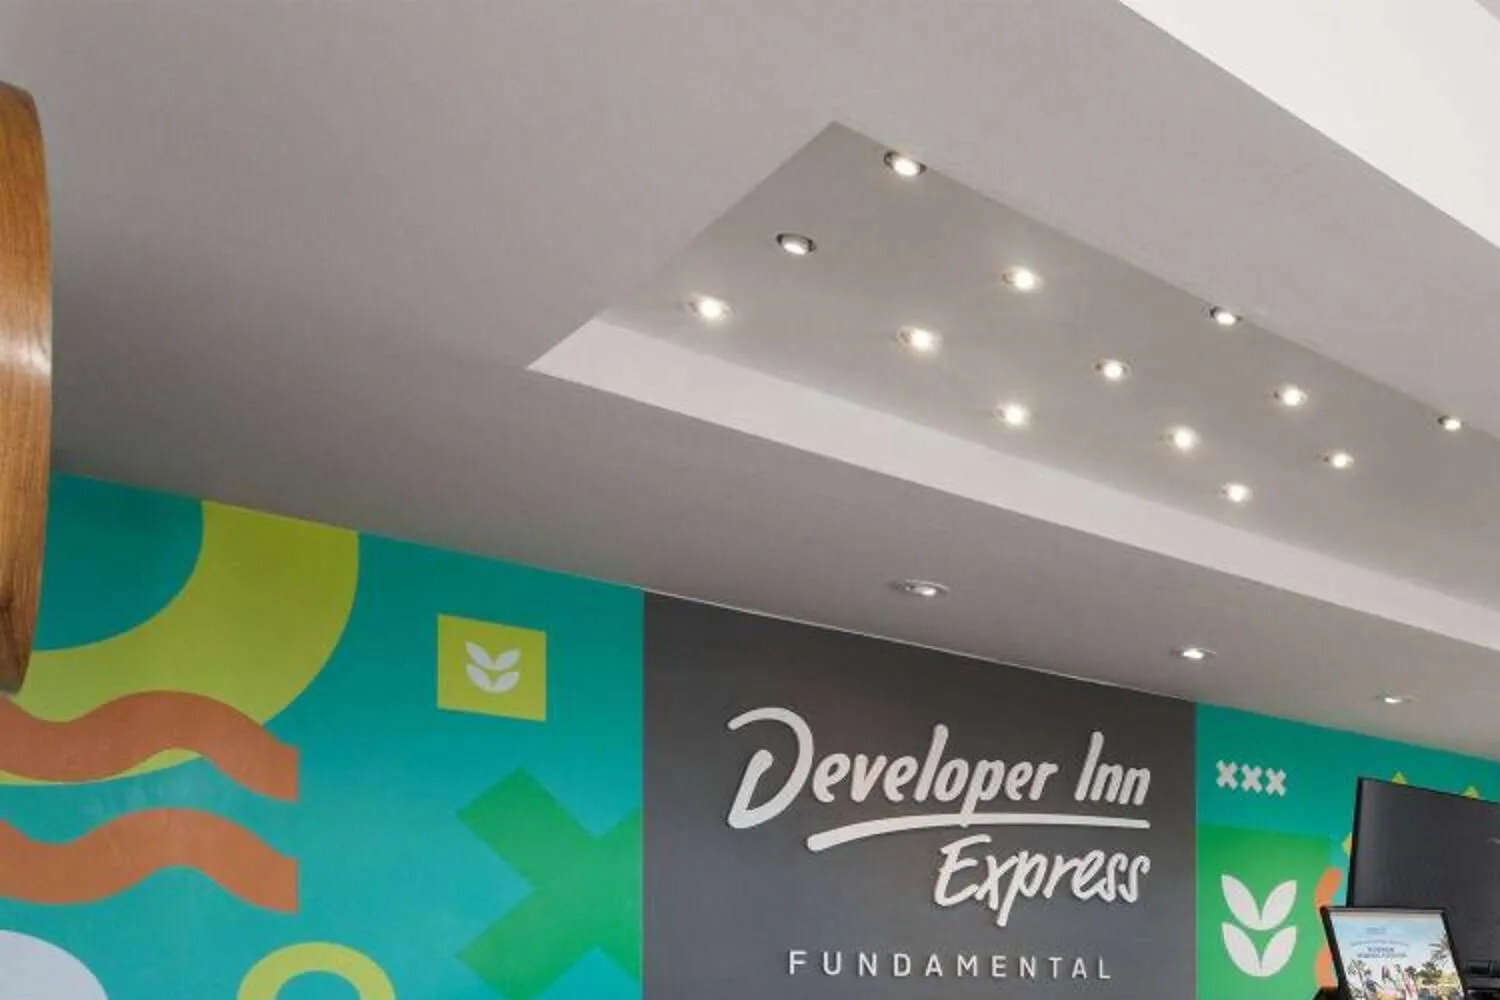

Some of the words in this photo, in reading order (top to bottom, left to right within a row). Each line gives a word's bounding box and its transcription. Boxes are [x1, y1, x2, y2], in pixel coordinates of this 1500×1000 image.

[727, 707, 1058, 829] Developer
[1074, 731, 1152, 805] Inn
[933, 833, 1152, 928] Express
[788, 949, 1112, 980] FUNDAMENTAL
